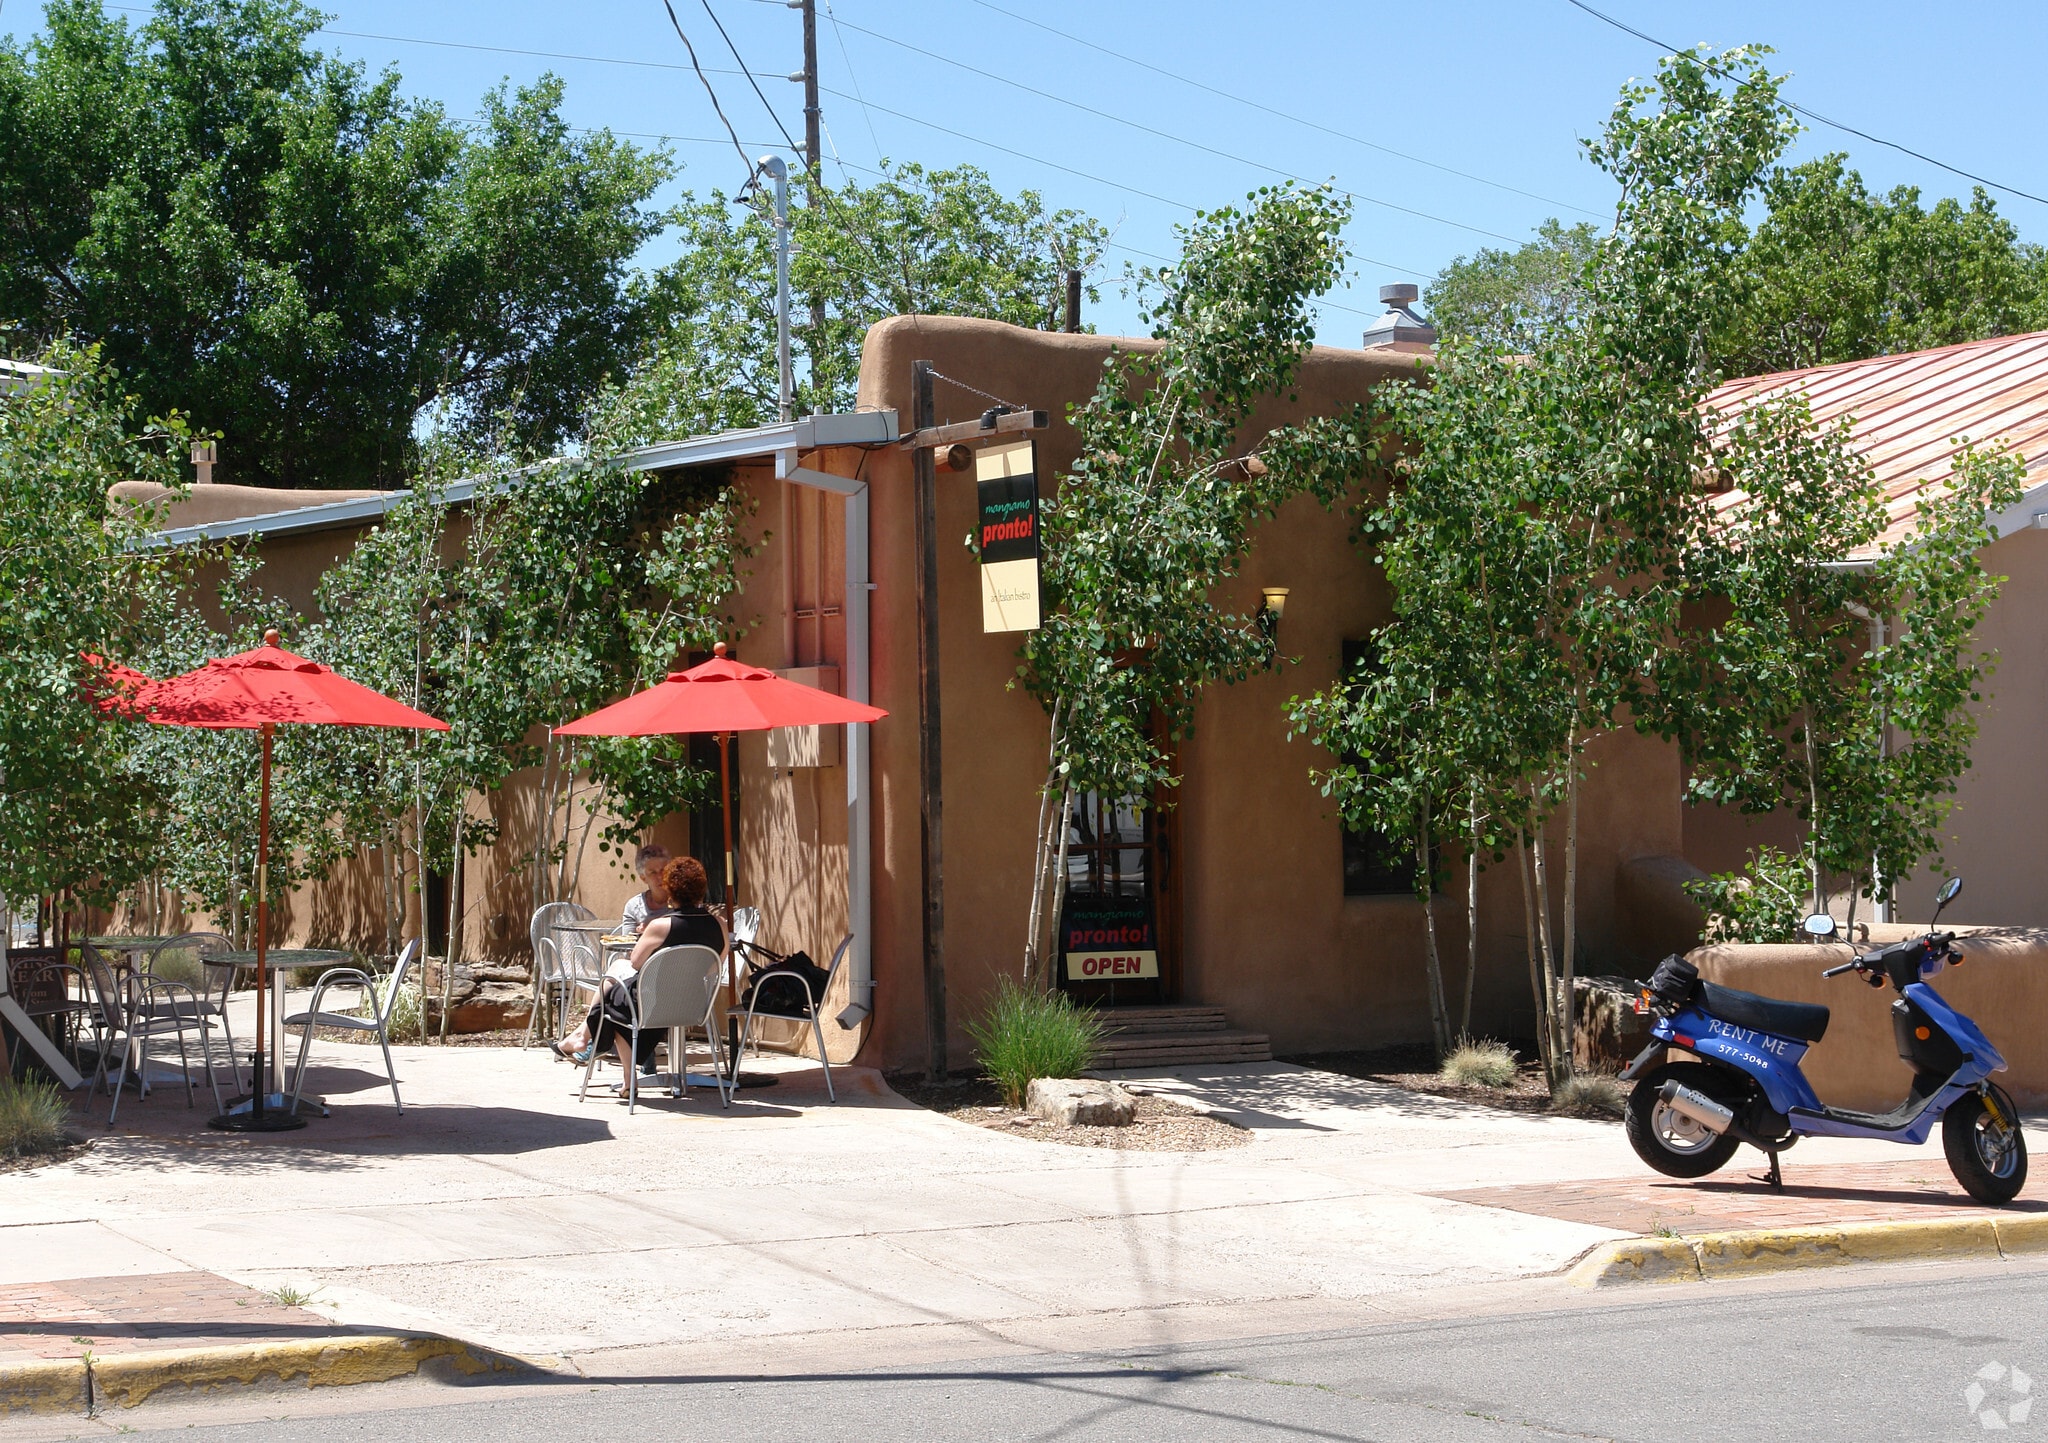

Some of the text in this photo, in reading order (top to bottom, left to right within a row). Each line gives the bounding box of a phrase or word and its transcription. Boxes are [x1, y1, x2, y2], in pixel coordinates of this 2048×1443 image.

[985, 498, 1031, 522] mangiamo
[982, 513, 1033, 548] pronto!
[1072, 909, 1144, 926] mangiamo
[1069, 924, 1149, 949] pronto!
[1081, 956, 1142, 976] OPEN
[1708, 1018, 1789, 1056] RENT ME
[1717, 1044, 1769, 1069] 577-5048
